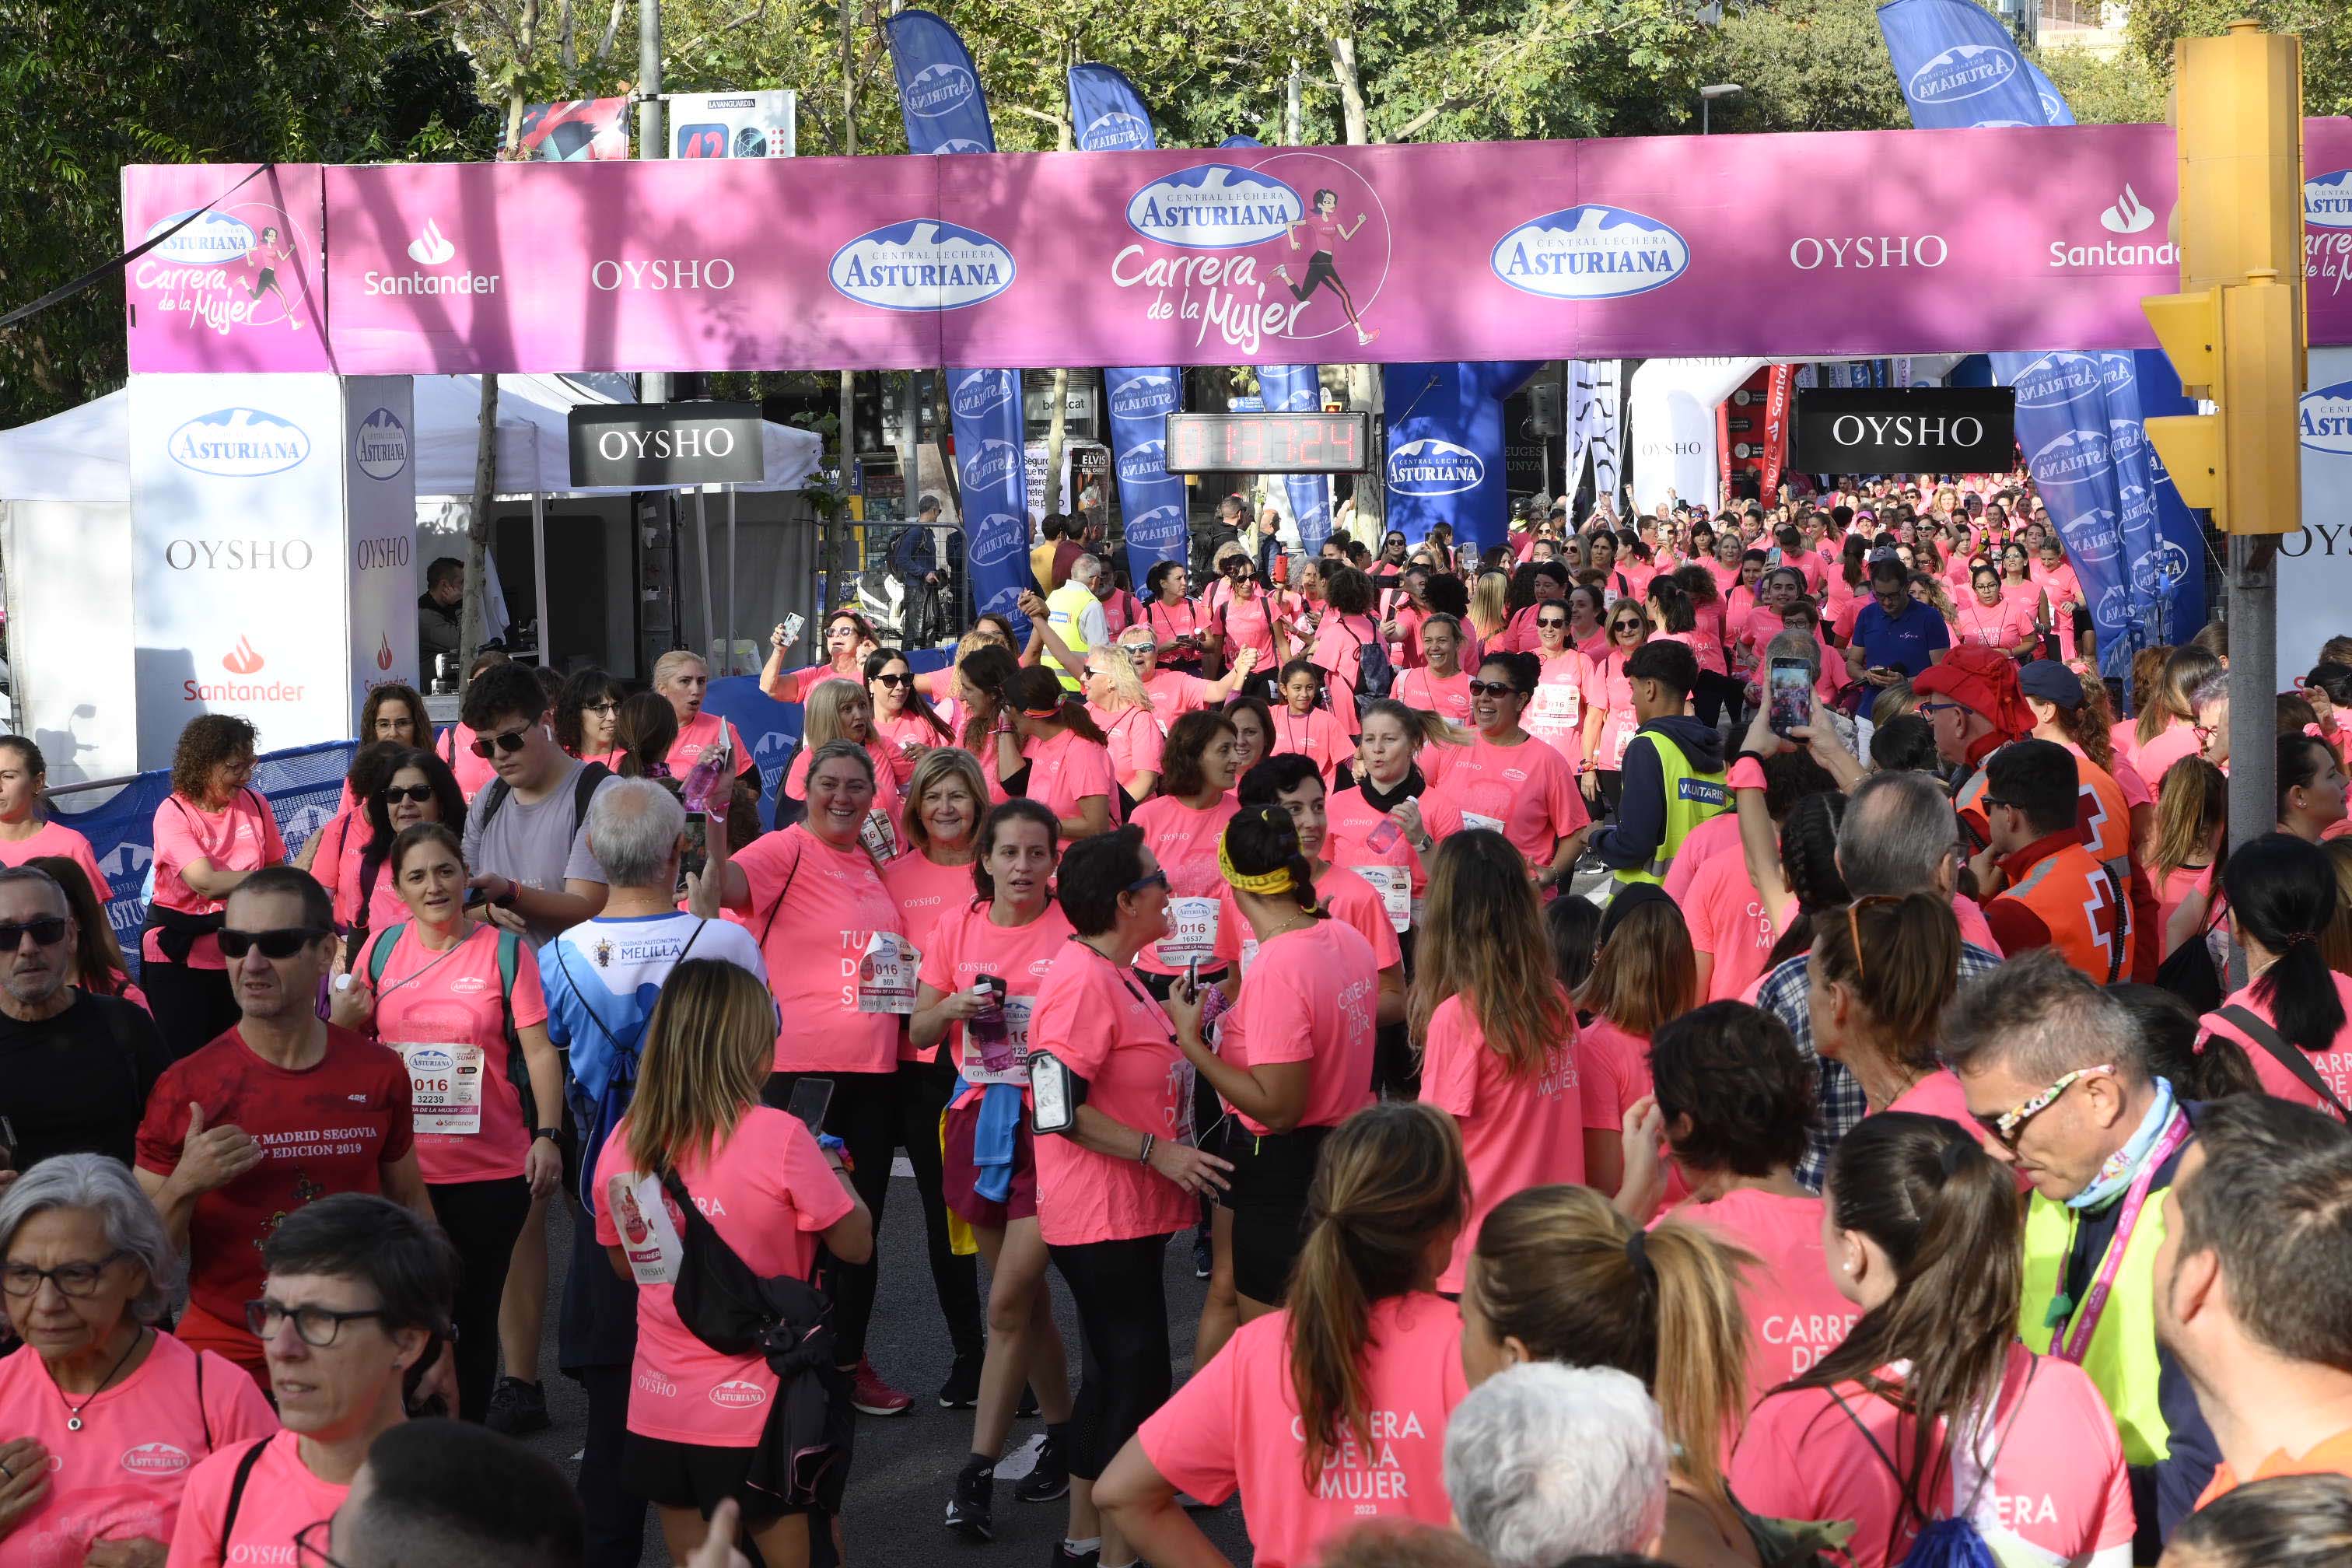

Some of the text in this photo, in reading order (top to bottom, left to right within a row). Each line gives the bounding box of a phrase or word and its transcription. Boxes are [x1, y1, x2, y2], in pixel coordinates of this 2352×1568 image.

[1167, 191, 1285, 202] CENTRAL LECHERA
[1140, 196, 1289, 228] ASTURIANA
[1537, 236, 1668, 248] CENTRAL LECHERA
[1790, 235, 1948, 270] OYSHO
[872, 250, 996, 261] CENTRAL LECHERA
[1111, 243, 1257, 289] Carrera
[1506, 240, 1675, 276] ASTURIANA
[135, 261, 227, 291] Carrera
[591, 258, 735, 291] OYSHO
[842, 254, 1002, 288] ASTURIANA
[364, 270, 500, 296] Santander
[158, 287, 262, 336] de la Mujer
[1146, 281, 1313, 355] de la Mujer
[1832, 415, 1983, 447] OYSHO
[180, 433, 299, 459] ASTURIANA
[359, 435, 405, 462] ASTURIANA
[599, 427, 734, 460] OYSHO
[1082, 455, 1106, 465] ELVIS
[1388, 462, 1477, 484] ASTURIANA
[165, 538, 313, 571] OYSHO
[356, 535, 410, 572] OYSHO
[183, 679, 306, 702] Santander
[1342, 817, 1373, 828] OYSHO
[1159, 832, 1190, 842] OYSHO
[904, 895, 942, 909] OYSHO
[1180, 922, 1206, 933] 016
[644, 936, 682, 946] AUTÓNOMA
[621, 943, 681, 961] MELILLA
[875, 964, 898, 975] 016
[958, 962, 998, 973] OYSHO
[412, 1057, 450, 1067] ASTURIANA
[414, 1078, 449, 1091] 016
[417, 1095, 445, 1104] 32239
[263, 1130, 320, 1146] MADRID
[323, 1126, 378, 1141] SEGOVIA
[273, 1143, 362, 1159] EDICION 2019
[637, 1374, 677, 1398] OYSHO
[713, 1390, 761, 1402] ASTURIANA
[125, 1454, 186, 1468] ASTURIANA
[1319, 1471, 1410, 1500] MUJER
[1354, 1504, 1377, 1515] 2023
